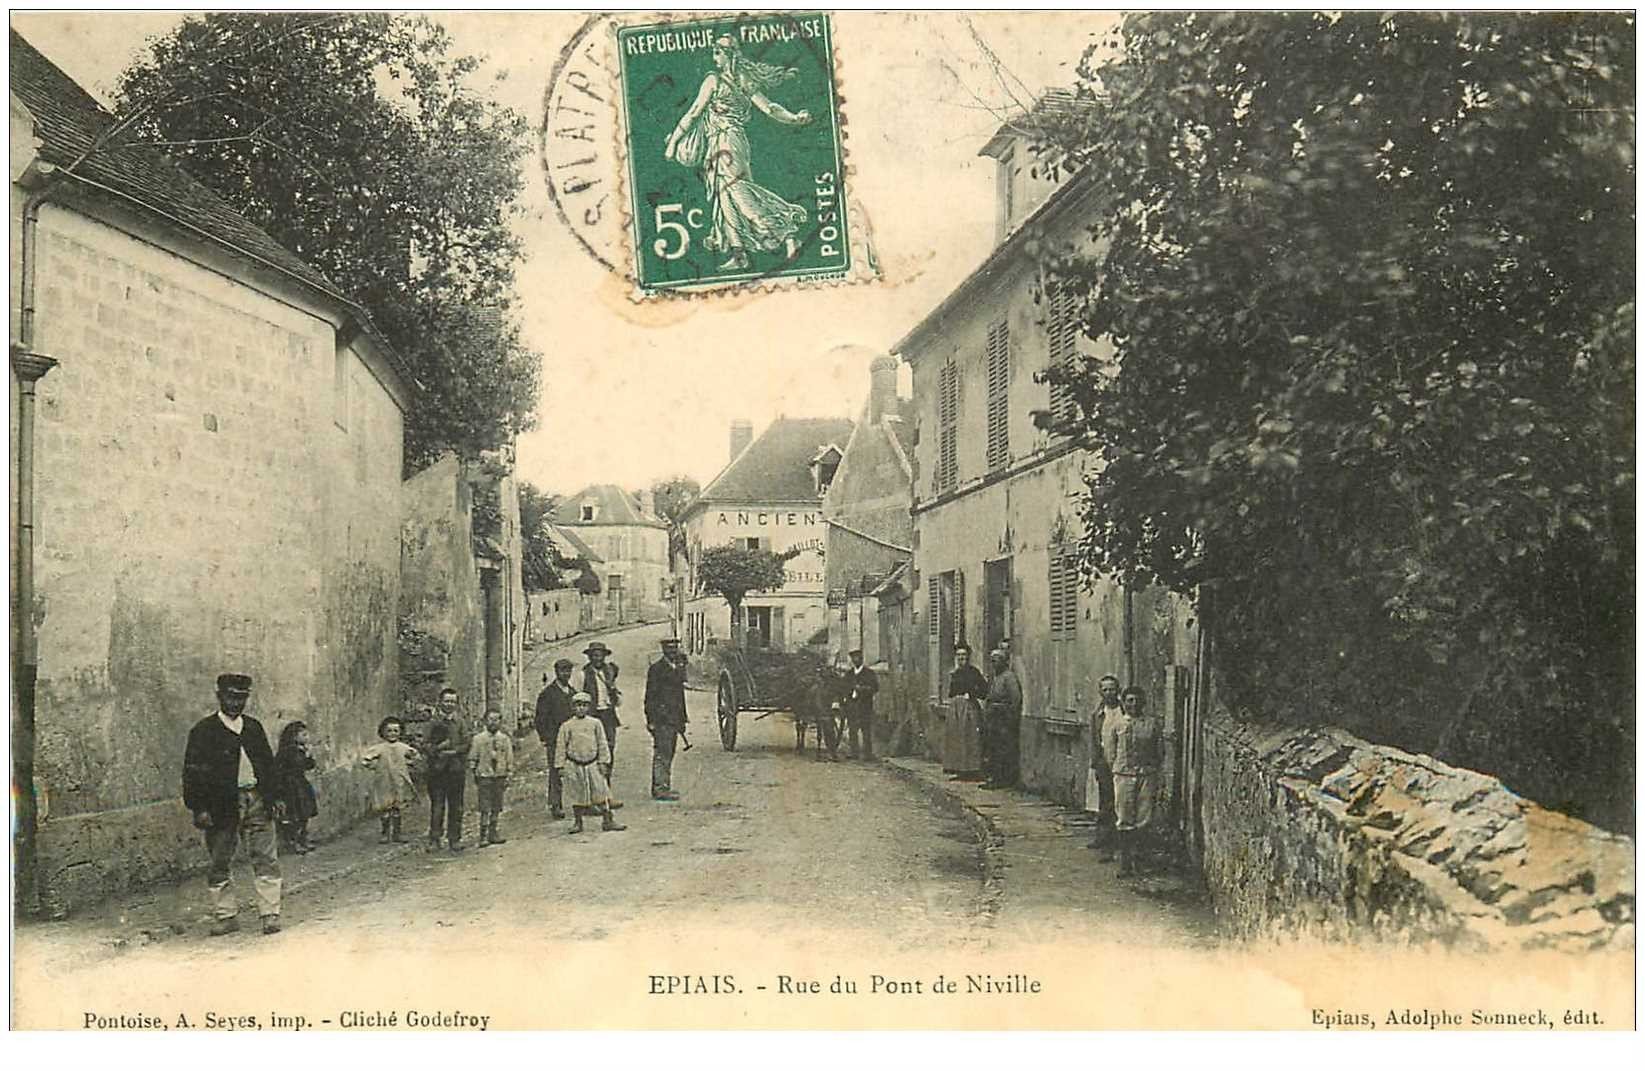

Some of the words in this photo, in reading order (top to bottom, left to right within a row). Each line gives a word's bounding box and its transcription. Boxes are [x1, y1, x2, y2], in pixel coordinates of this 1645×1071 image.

[740, 19, 821, 43] FRANÇAISE
[815, 172, 839, 257] POSTES
[717, 513, 815, 526] ANCIEN
